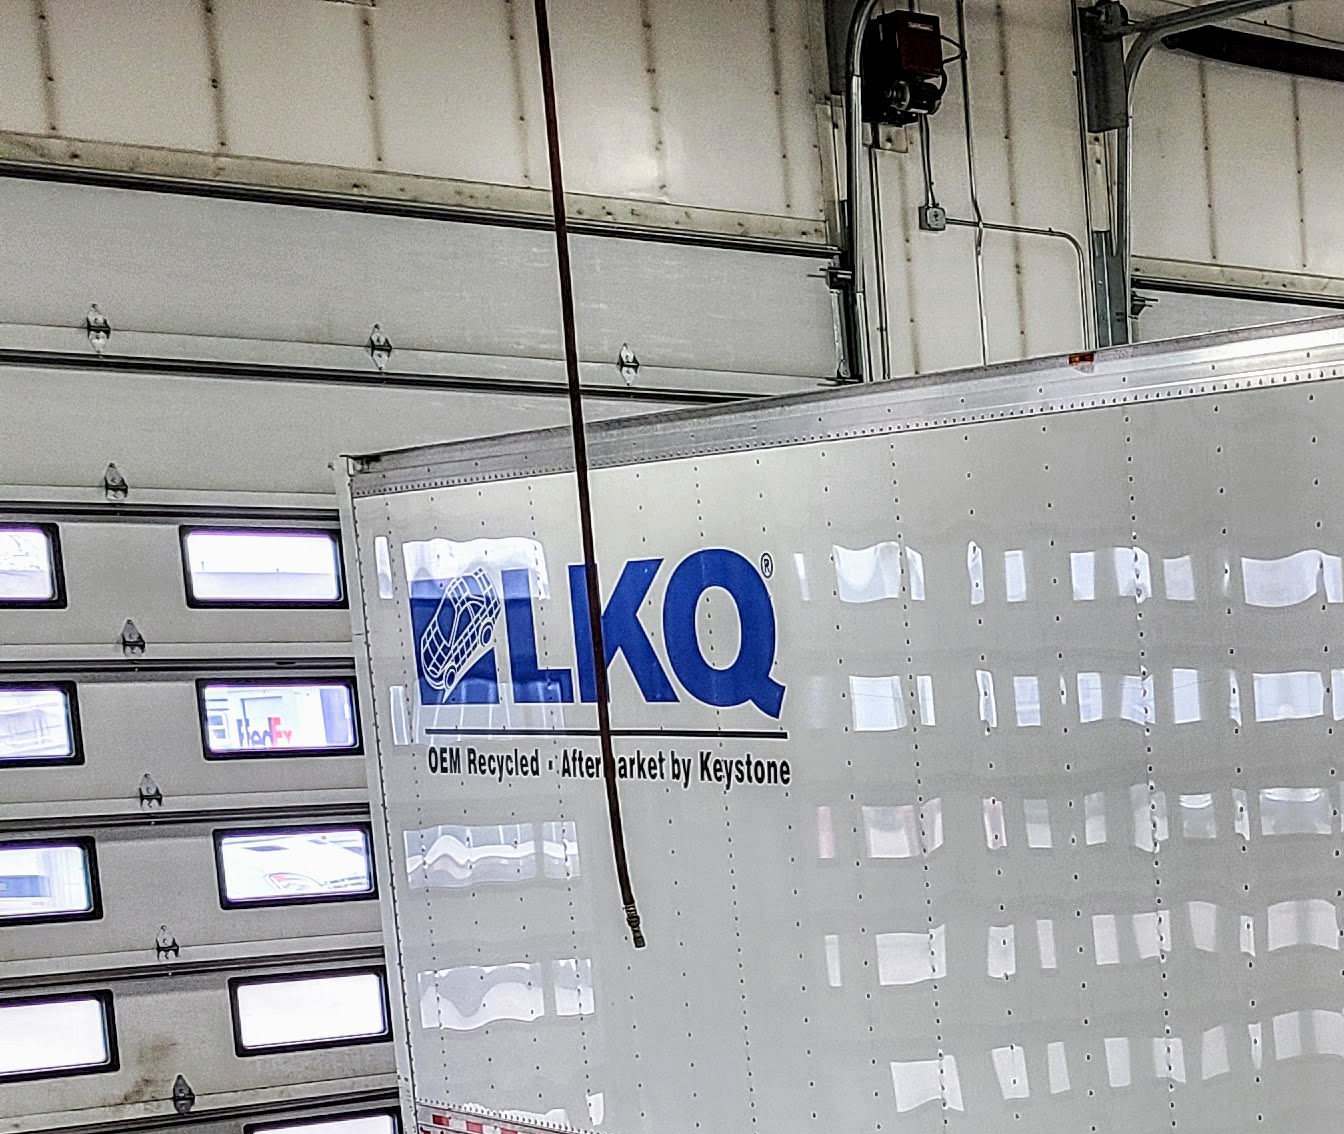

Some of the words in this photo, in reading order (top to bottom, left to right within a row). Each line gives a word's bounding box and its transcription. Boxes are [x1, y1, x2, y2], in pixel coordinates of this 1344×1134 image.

[428, 746, 462, 774] OEM
[467, 748, 540, 783] Recycled
[561, 749, 666, 780] Afterarket
[671, 750, 692, 789] by
[700, 751, 791, 790] Keystone
